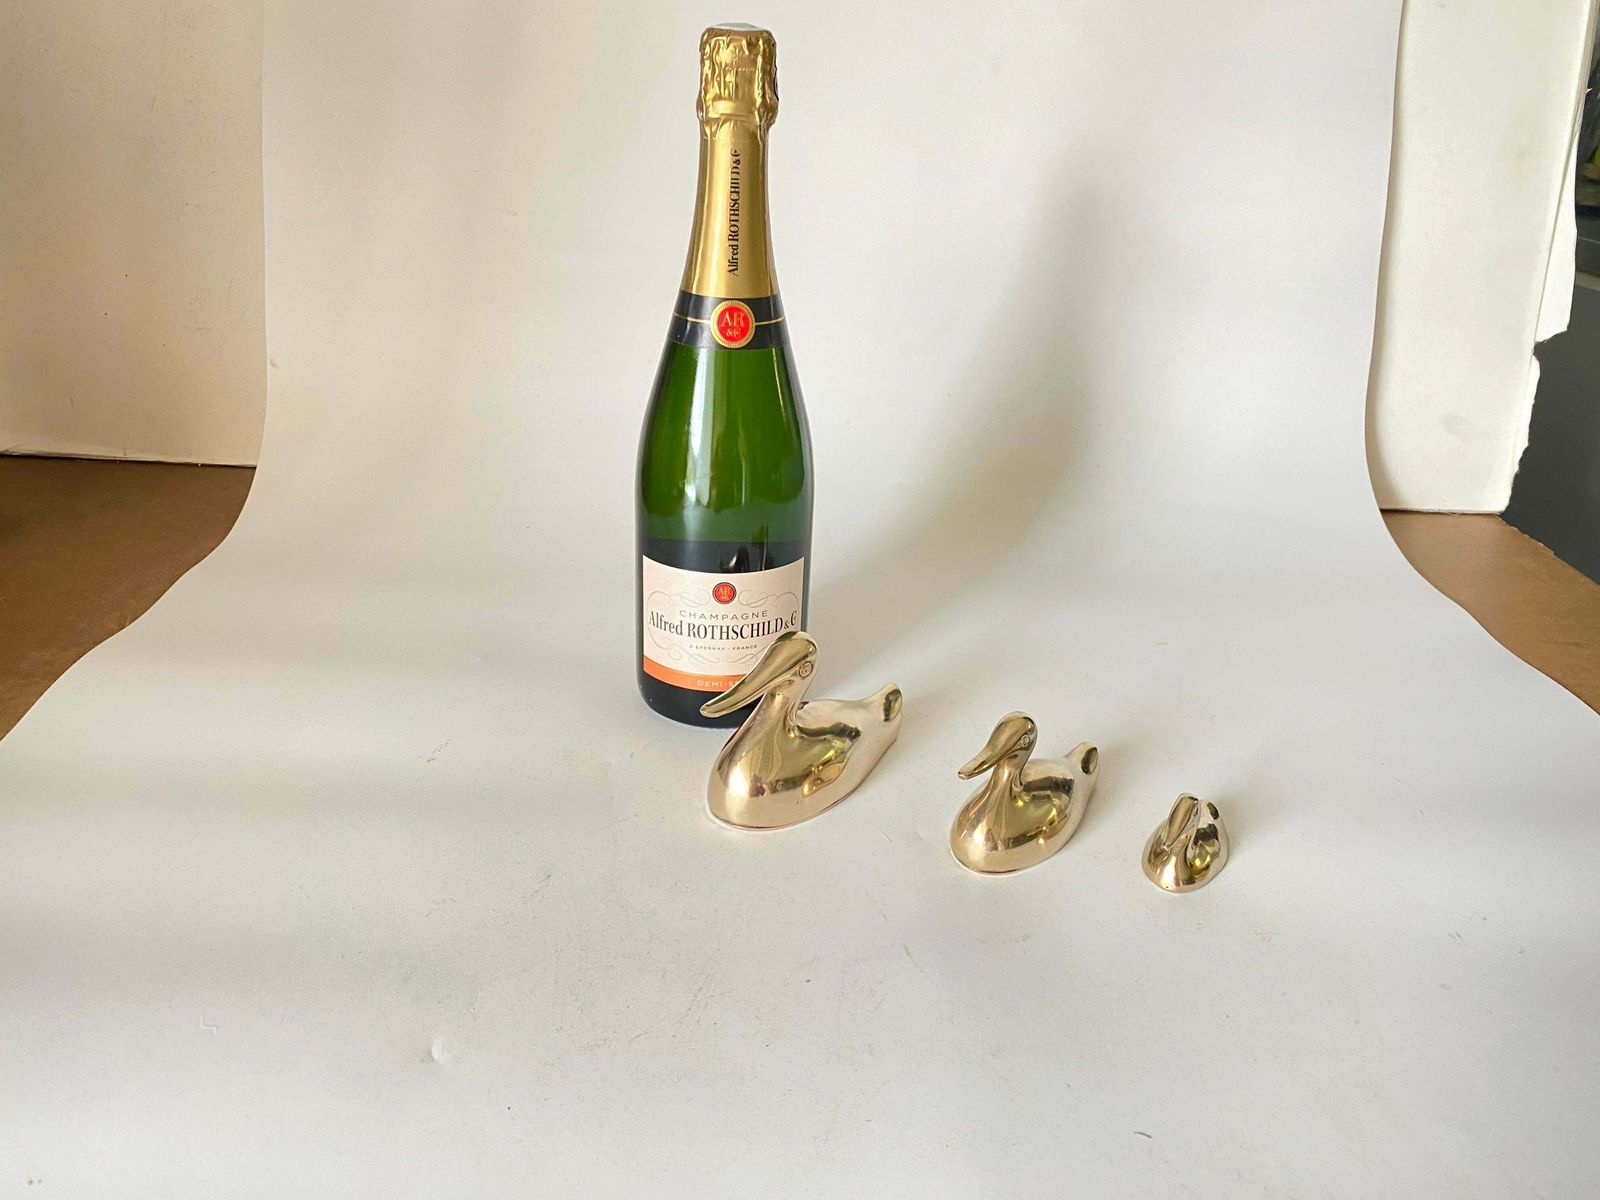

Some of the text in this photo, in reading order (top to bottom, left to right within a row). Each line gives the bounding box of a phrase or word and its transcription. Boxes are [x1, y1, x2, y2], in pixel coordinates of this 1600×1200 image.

[728, 244, 739, 277] Alfred
[721, 310, 745, 327] AR
[649, 611, 683, 637] Alfred
[679, 609, 769, 621] CHAMPAGNE
